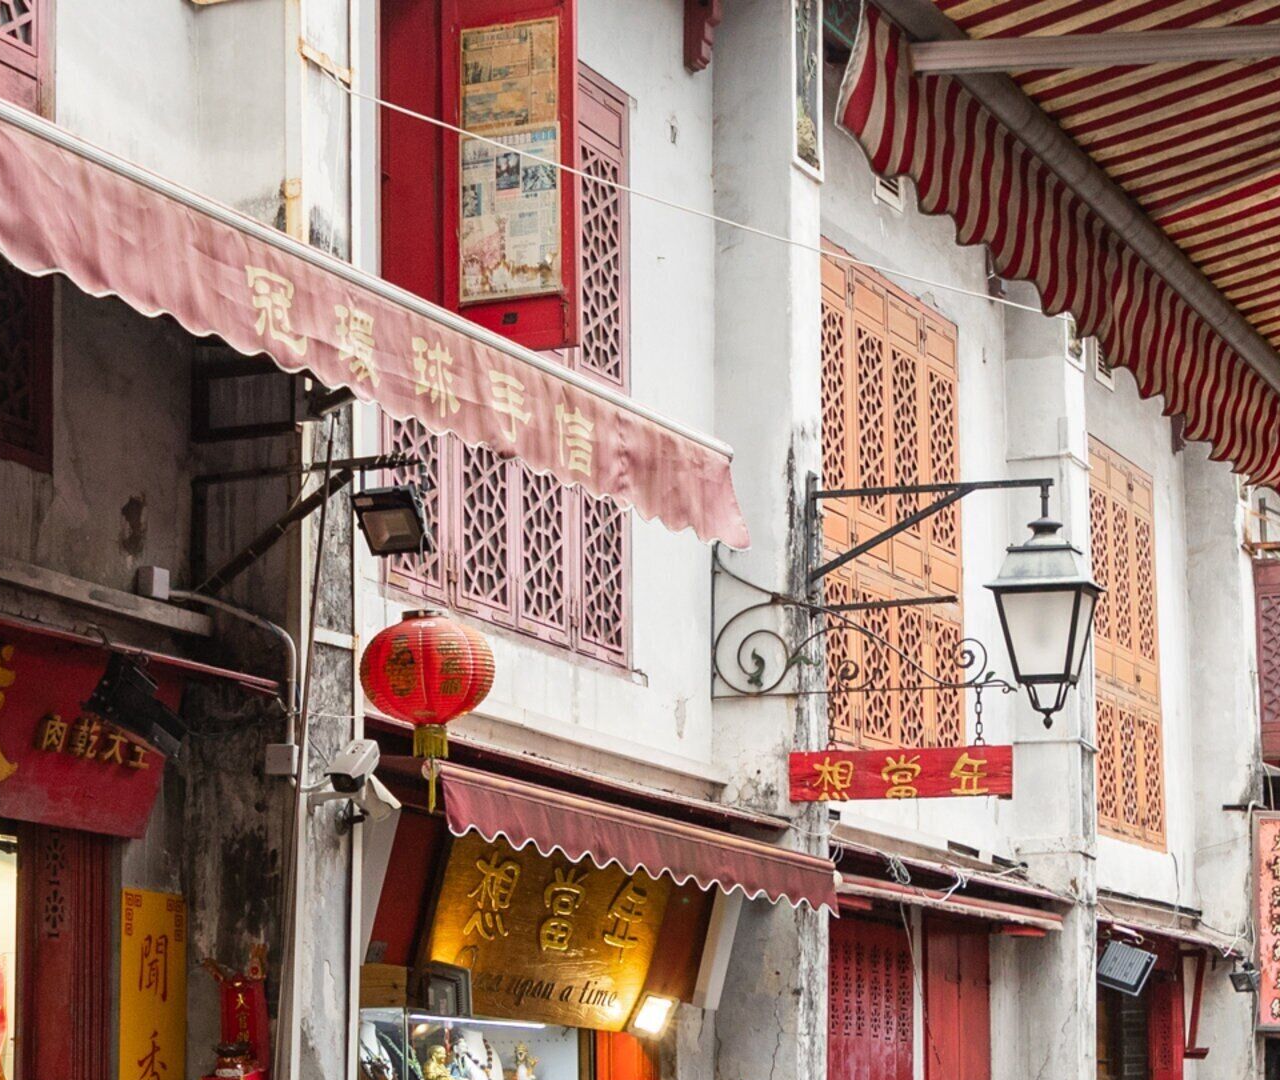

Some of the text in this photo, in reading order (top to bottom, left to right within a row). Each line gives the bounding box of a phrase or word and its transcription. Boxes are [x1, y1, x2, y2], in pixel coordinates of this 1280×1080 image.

[244, 265, 596, 478] 冠環球手信
[505, 976, 556, 1008] upon
[559, 983, 574, 1001] a
[578, 980, 620, 1009] time
